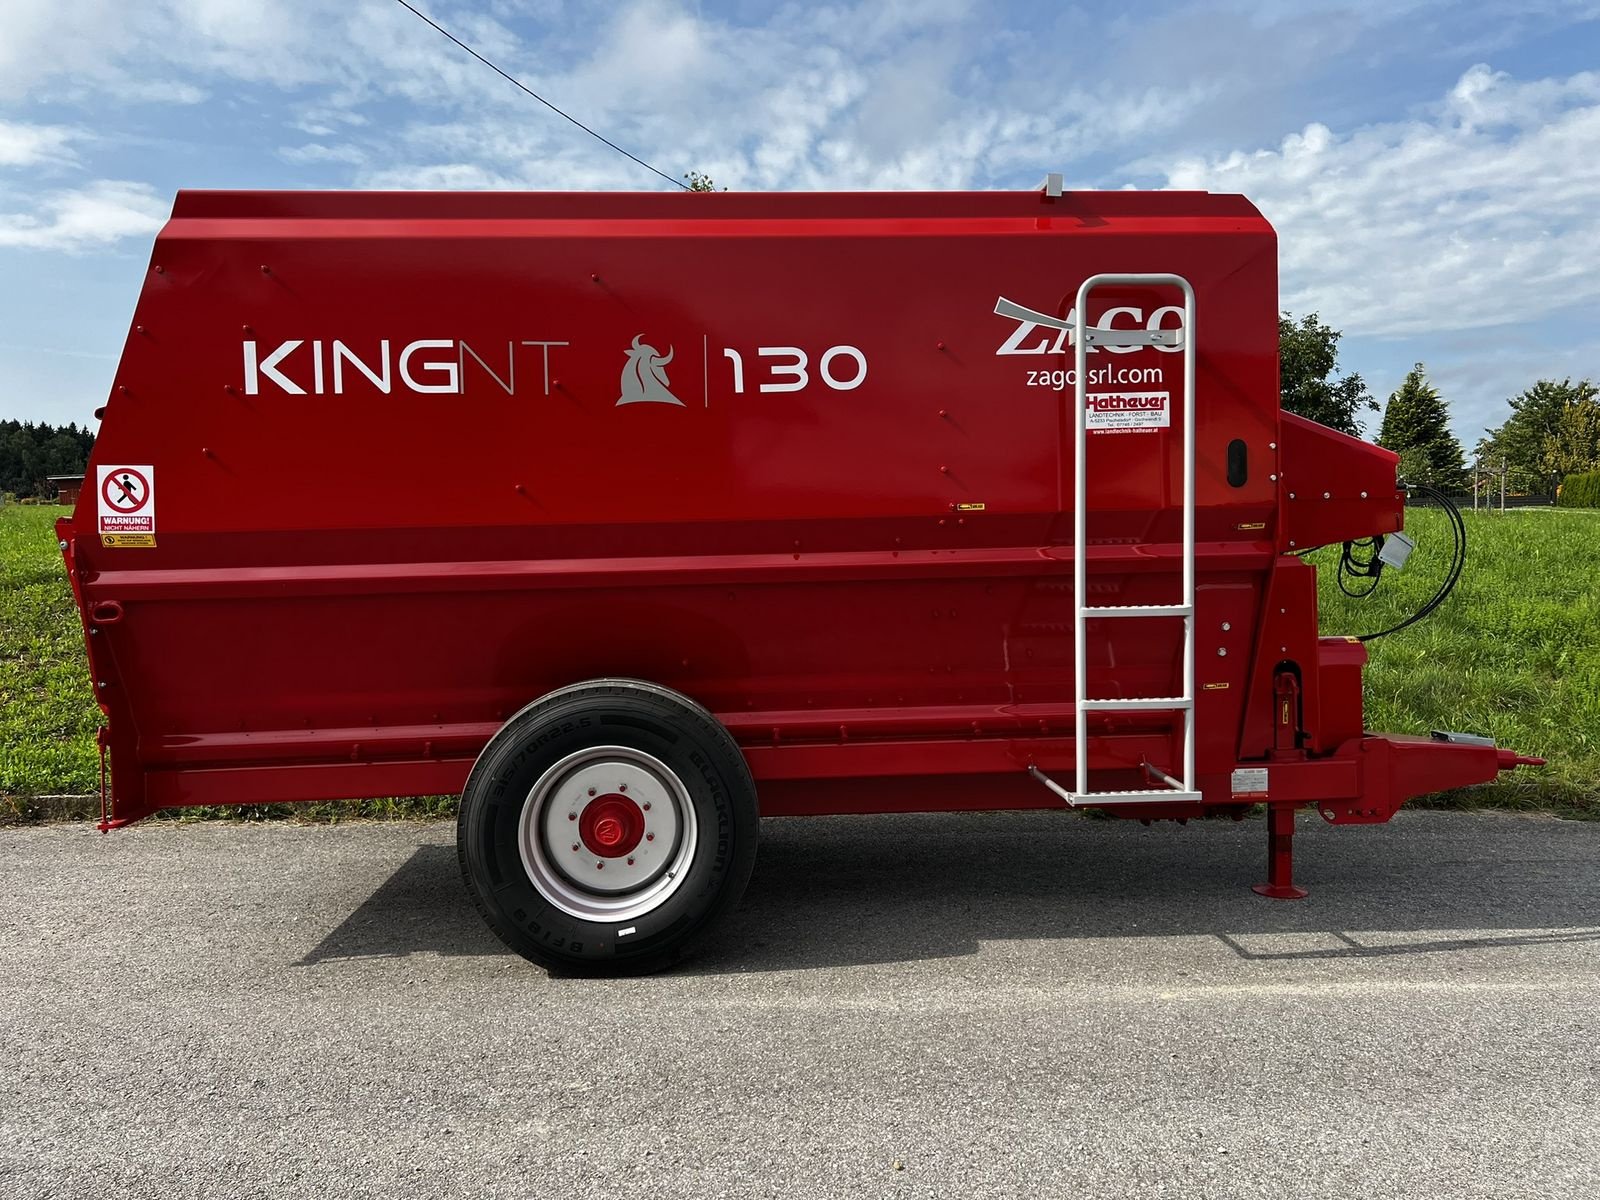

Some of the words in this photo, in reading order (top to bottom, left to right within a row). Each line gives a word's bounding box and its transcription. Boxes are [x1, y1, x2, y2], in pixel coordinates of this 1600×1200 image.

[723, 345, 867, 394] 130
[1086, 395, 1167, 412] Hatheuer
[103, 517, 150, 525] WARNUNG!
[493, 717, 592, 798] 315/70R22.5
